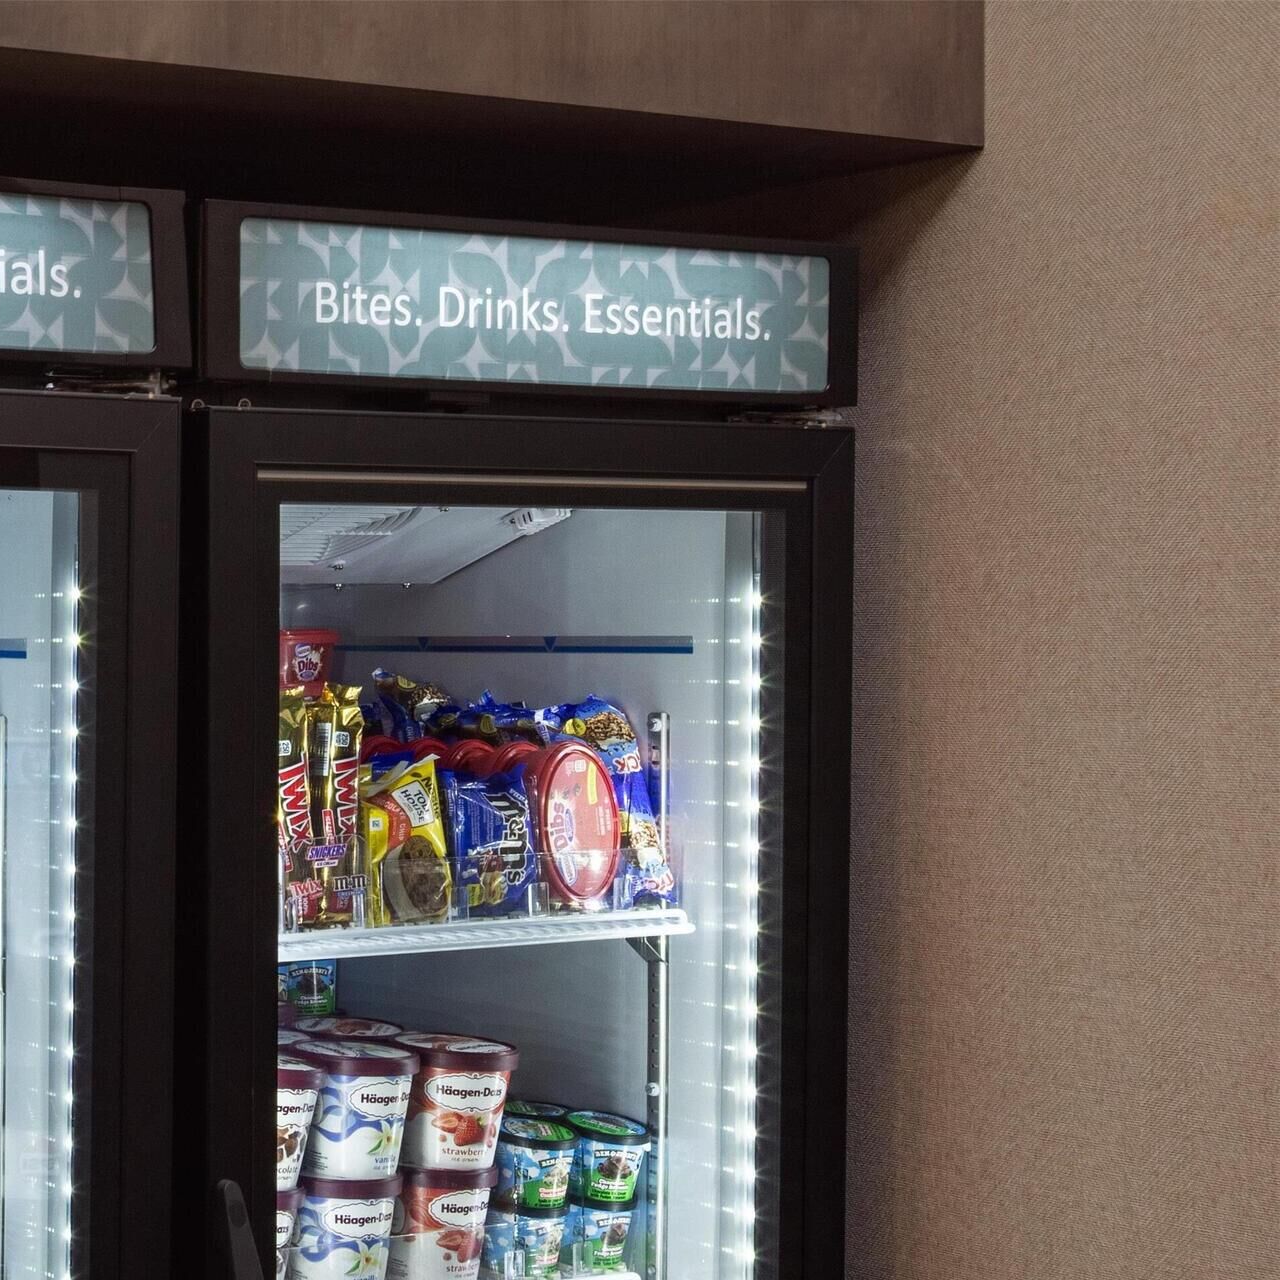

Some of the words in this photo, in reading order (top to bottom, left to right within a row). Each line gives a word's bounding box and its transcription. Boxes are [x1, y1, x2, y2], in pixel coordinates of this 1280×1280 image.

[315, 281, 423, 327] Bites.
[439, 286, 569, 333] Drinks.
[585, 292, 771, 342] Essentials.
[297, 657, 319, 673] Dibs
[401, 789, 425, 824] HOUSE
[308, 843, 347, 859] SNICKERS
